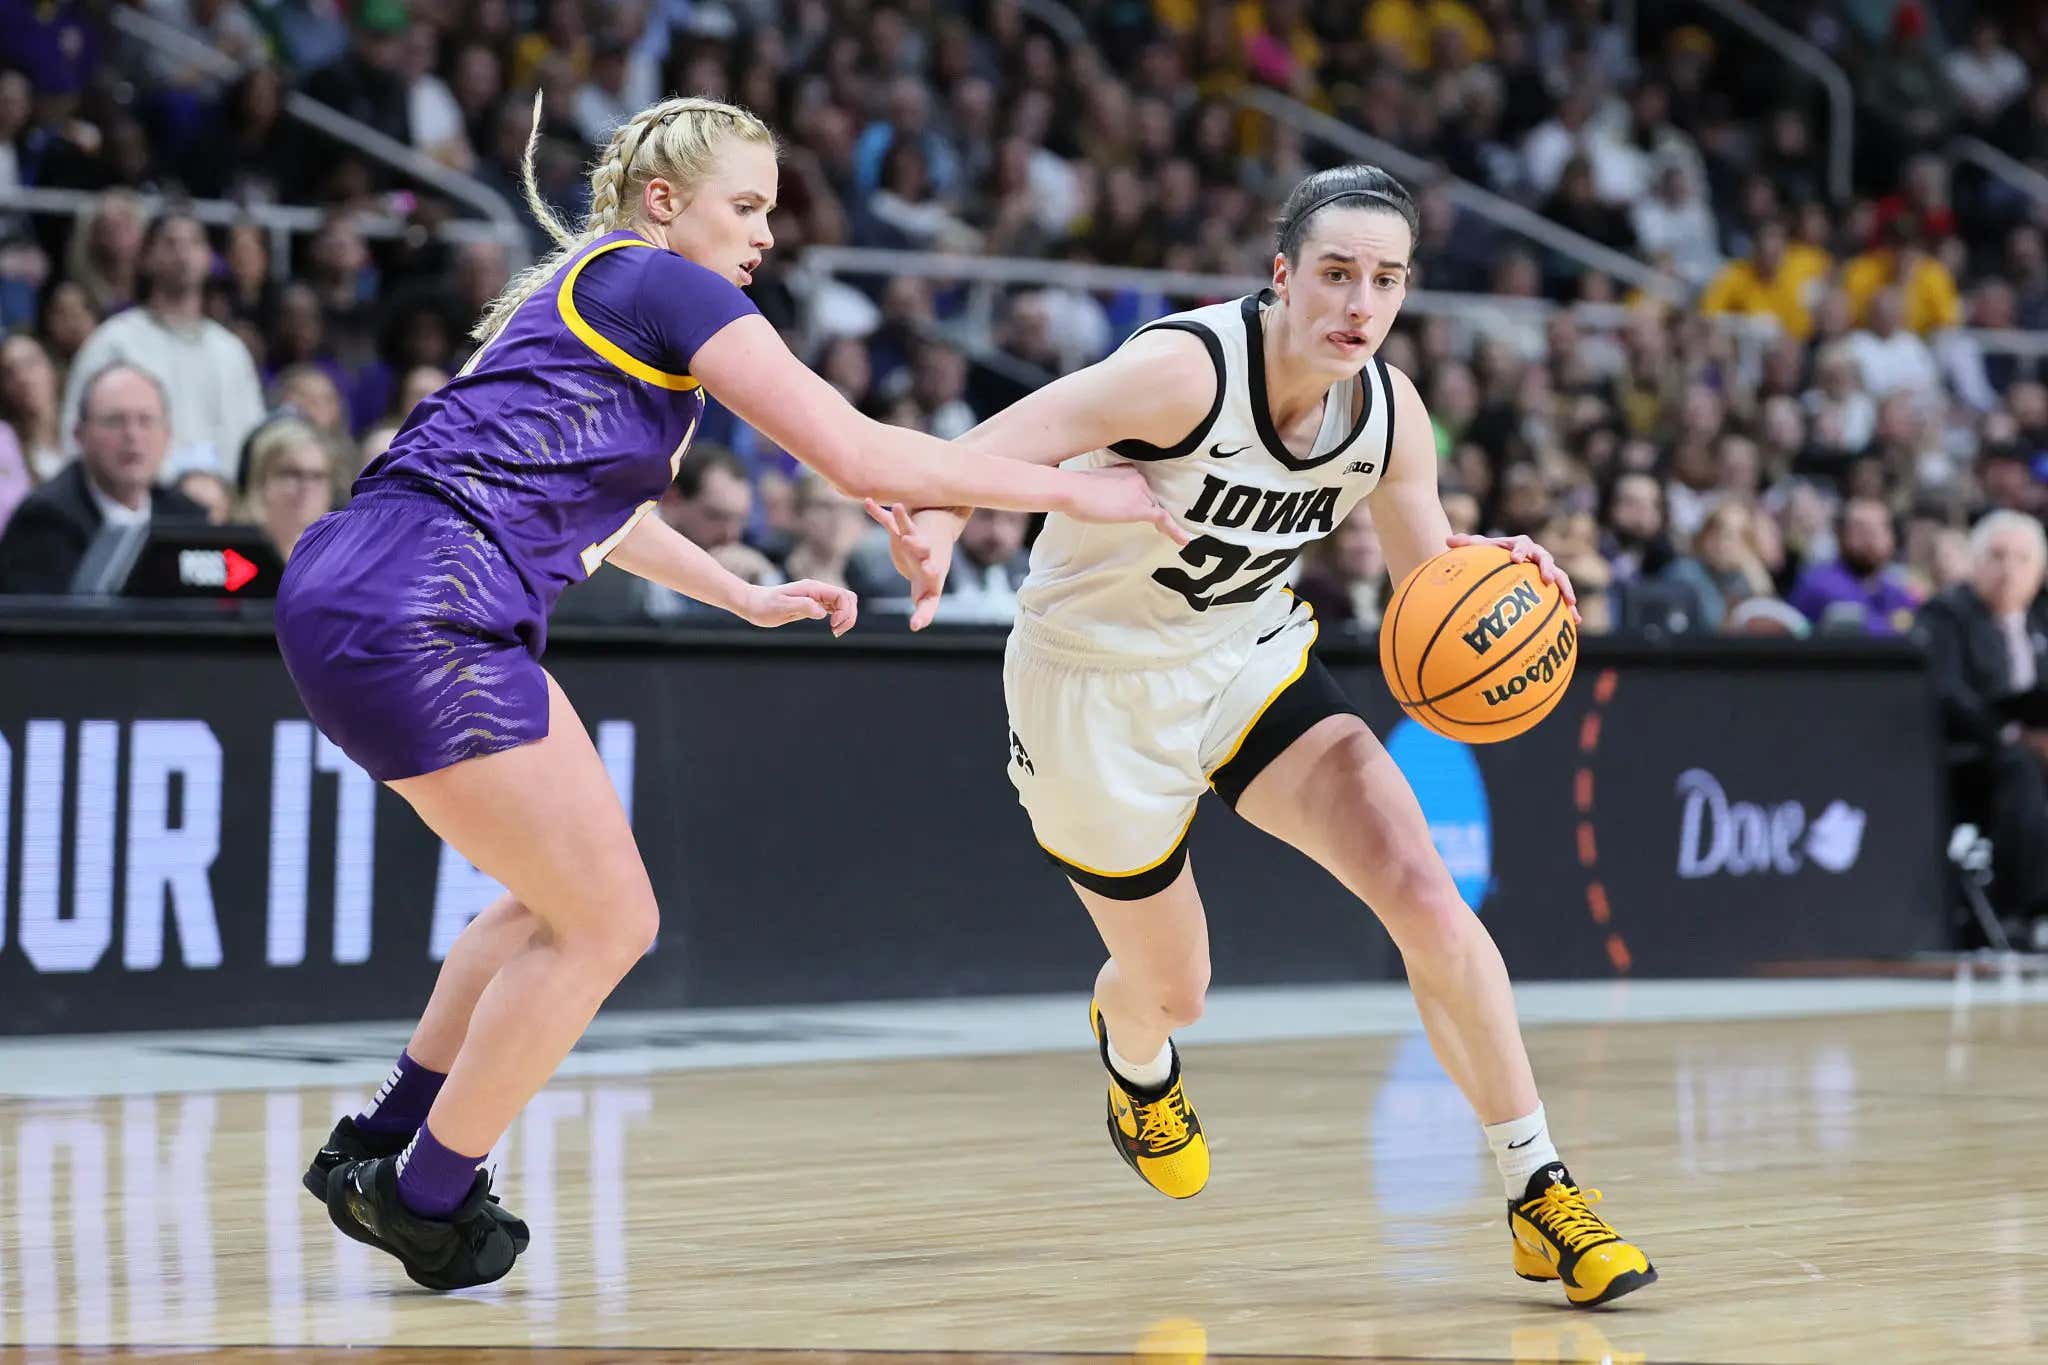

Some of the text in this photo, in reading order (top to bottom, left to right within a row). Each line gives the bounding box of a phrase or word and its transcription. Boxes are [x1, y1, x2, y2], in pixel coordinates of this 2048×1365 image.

[1184, 474, 1343, 534] IOWA
[1151, 534, 1303, 612] 22
[1462, 579, 1541, 655] NCAA
[1482, 619, 1575, 706] Wilson
[0, 719, 223, 973] UR
[1675, 767, 1806, 879] Dove
